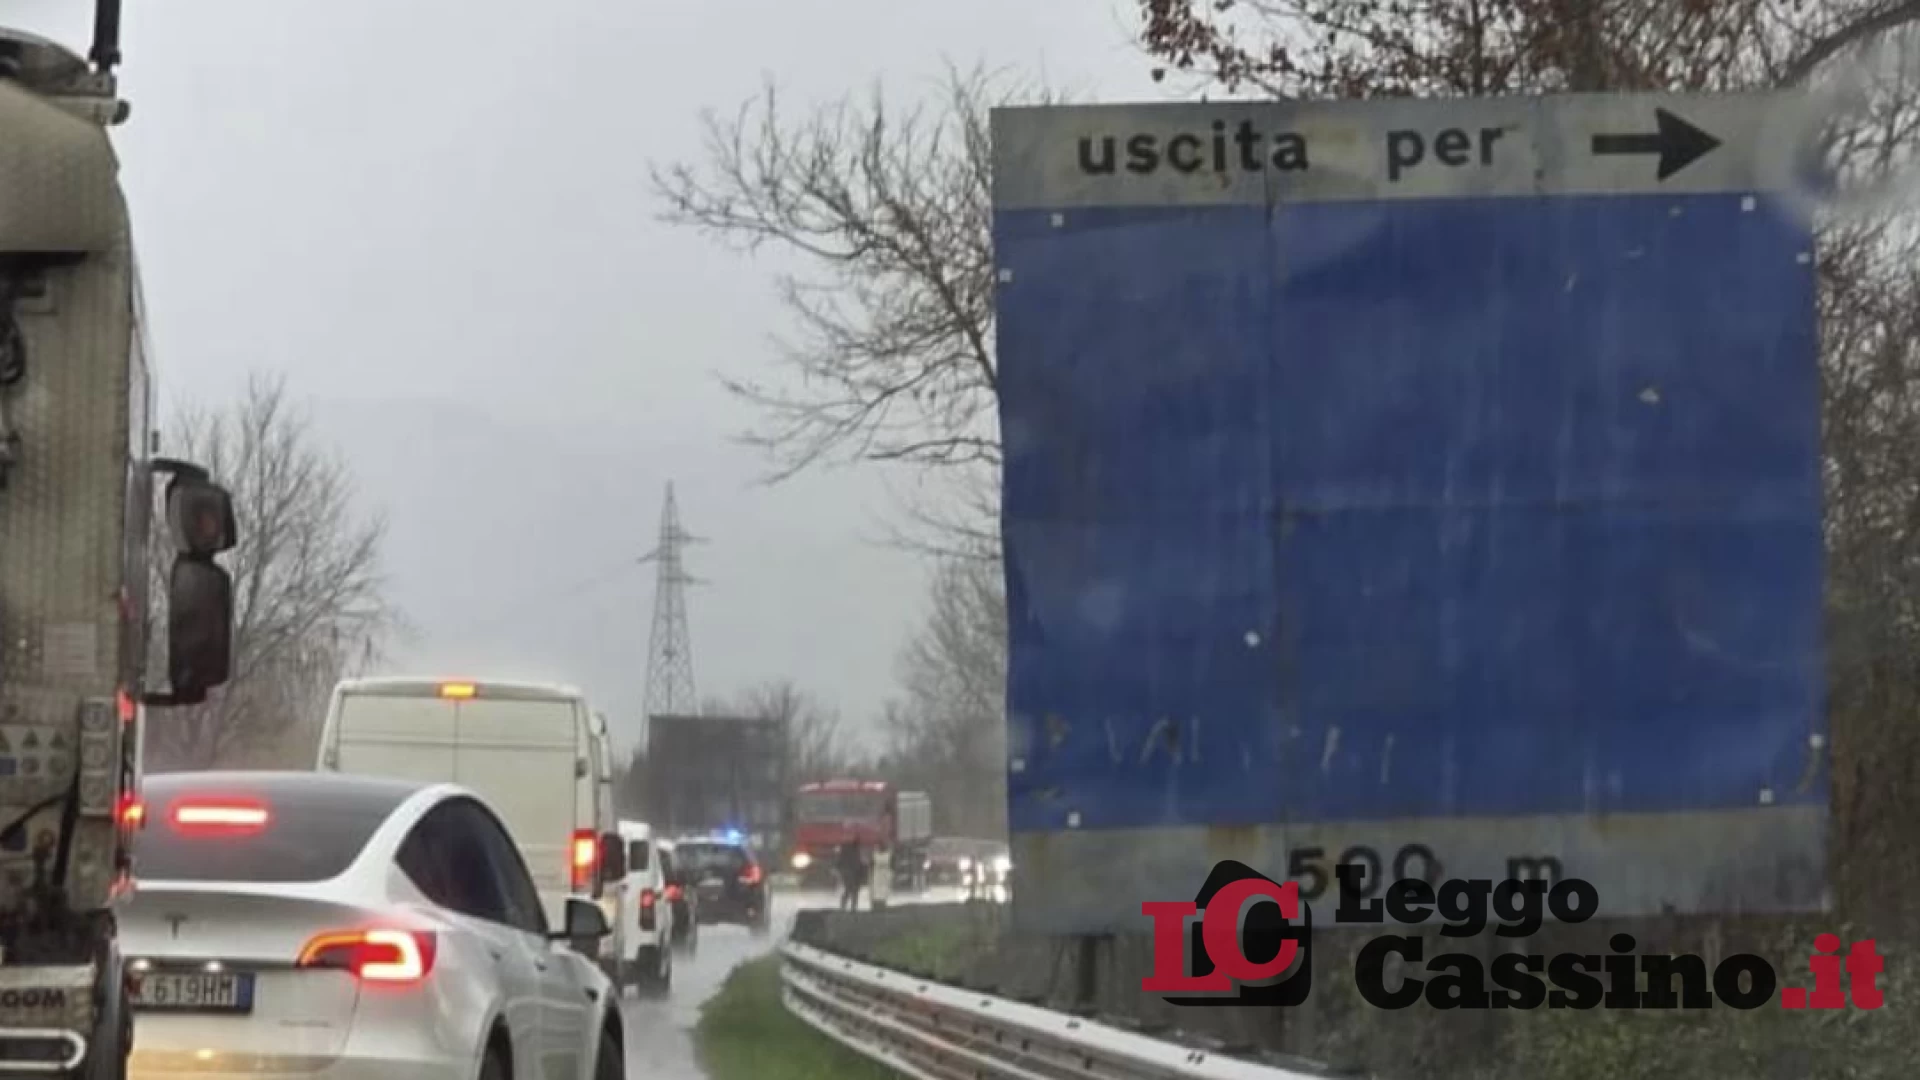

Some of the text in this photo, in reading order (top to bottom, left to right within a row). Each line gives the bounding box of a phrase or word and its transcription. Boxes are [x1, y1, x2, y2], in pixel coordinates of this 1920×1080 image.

[1078, 118, 1504, 183] uscita per
[1287, 843, 1438, 902] 500
